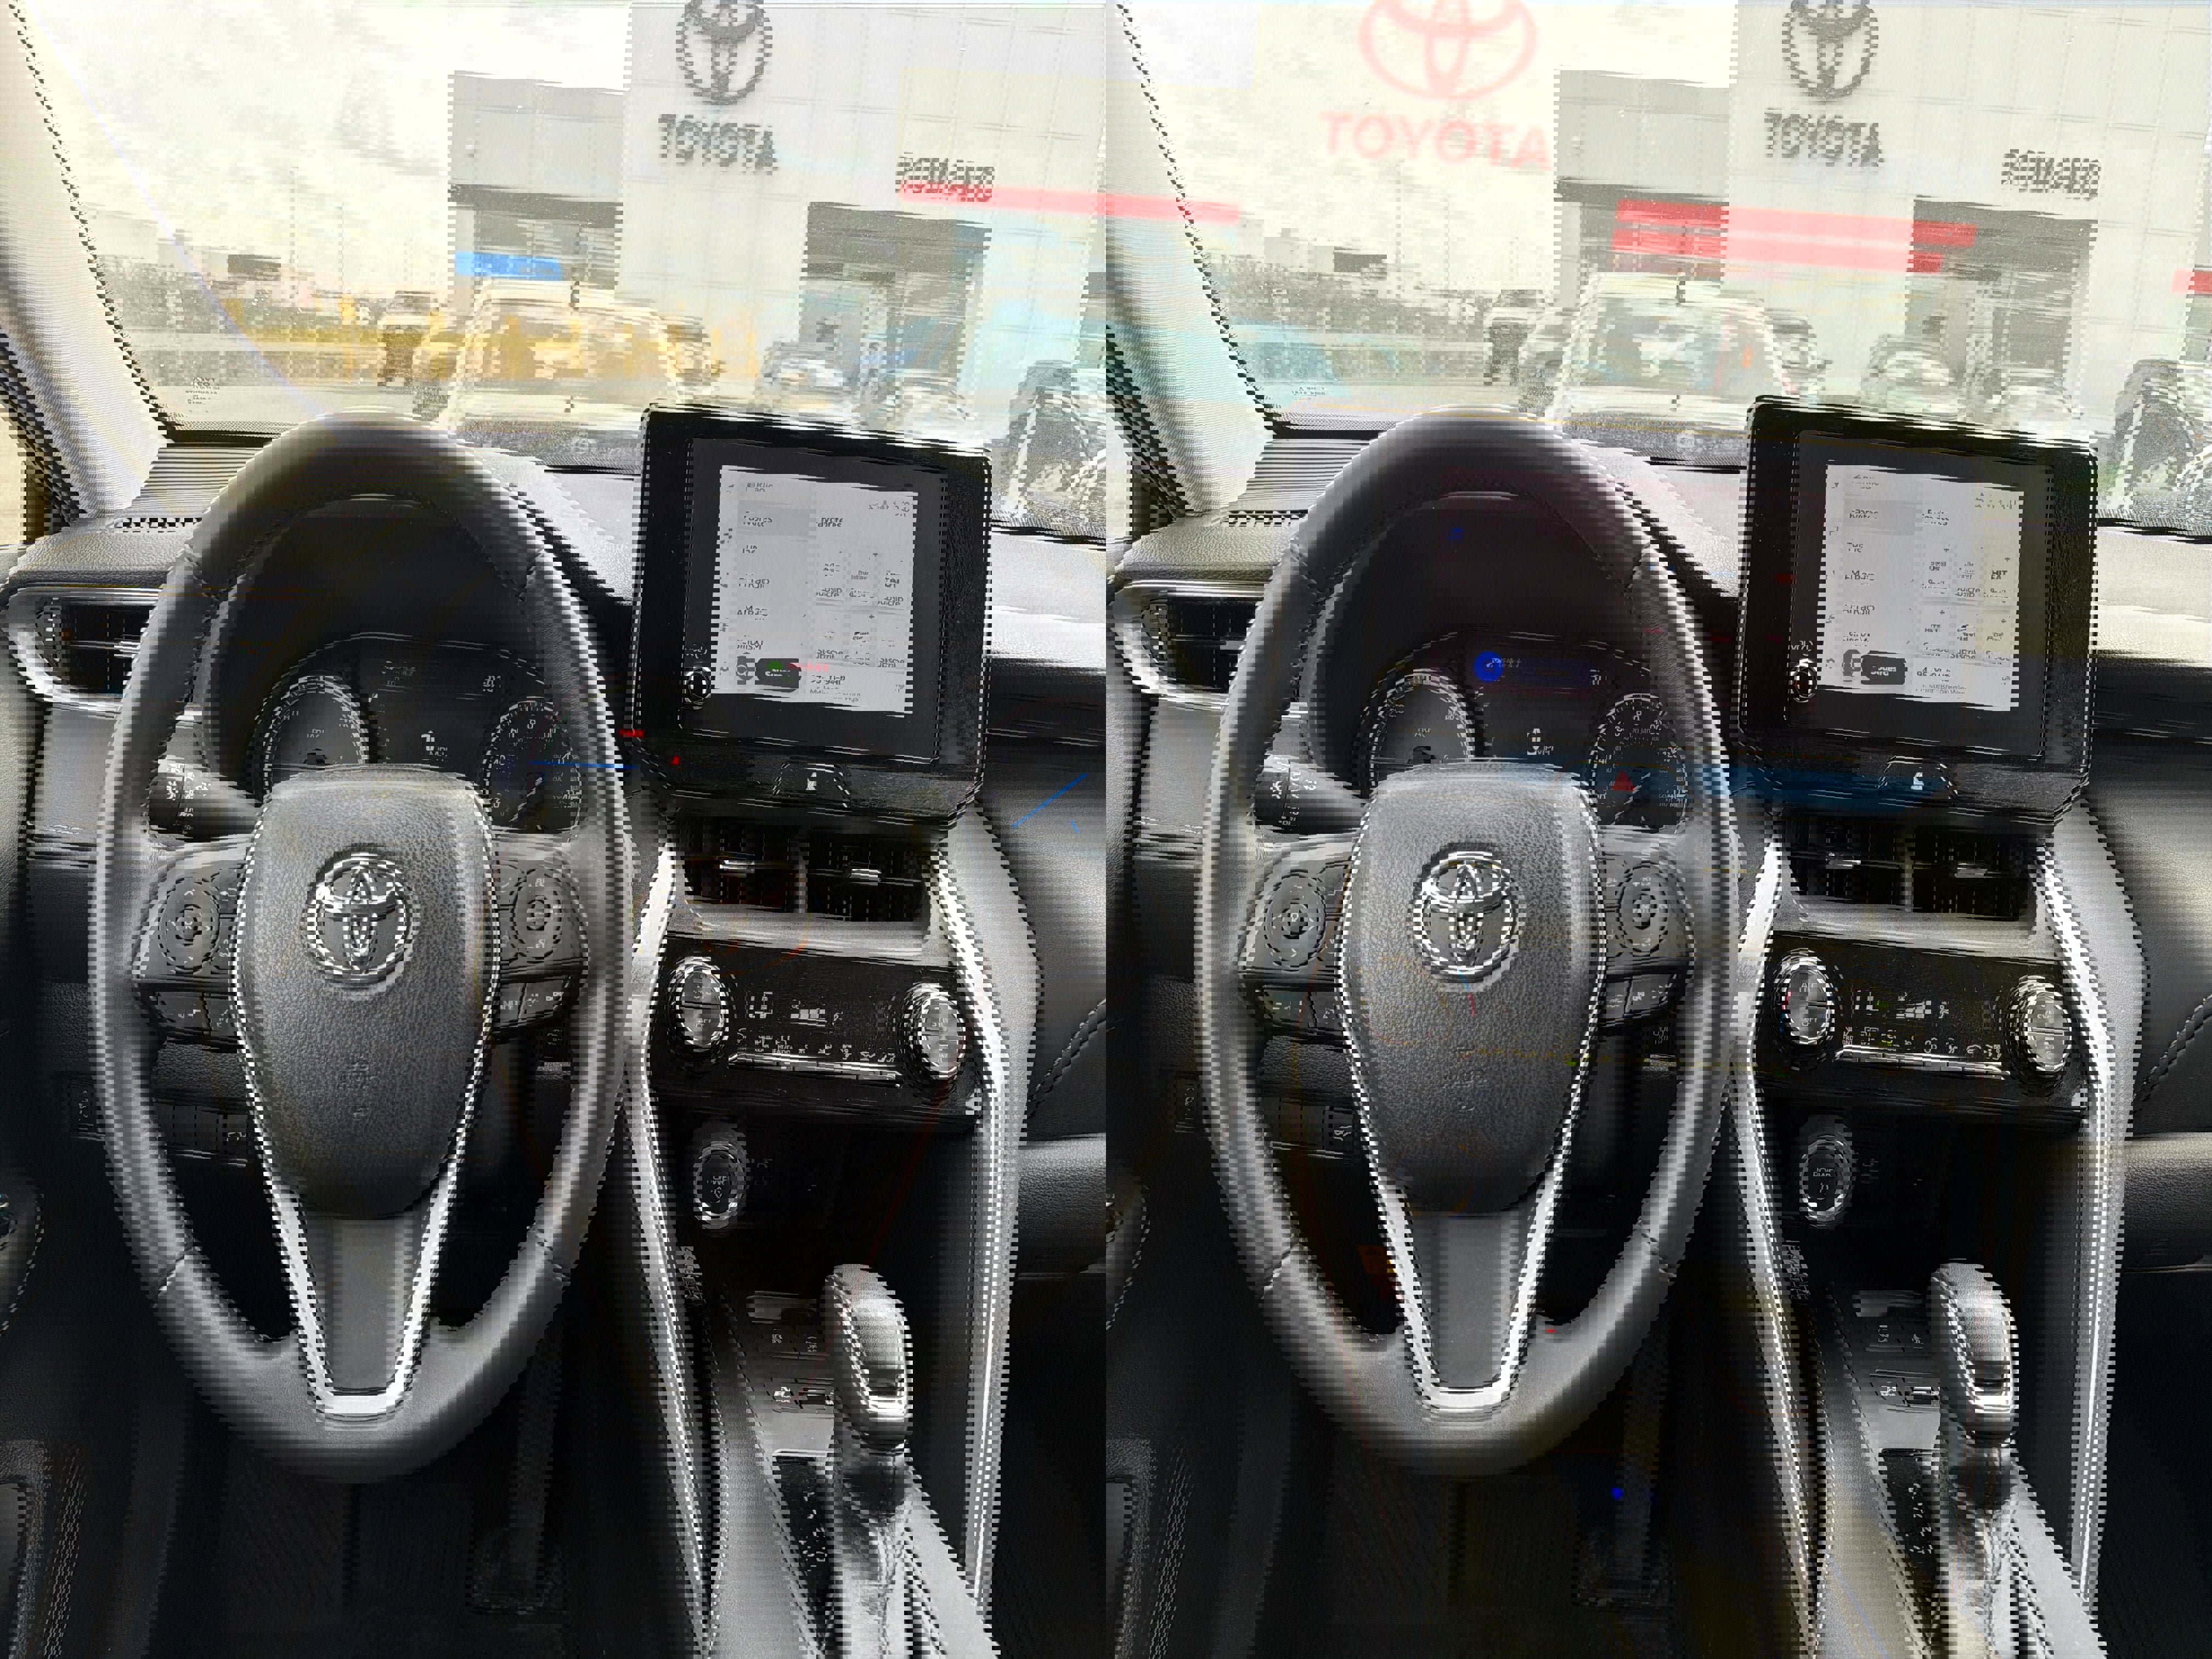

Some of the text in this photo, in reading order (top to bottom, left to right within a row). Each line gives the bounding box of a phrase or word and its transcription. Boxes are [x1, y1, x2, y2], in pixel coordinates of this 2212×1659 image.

[1318, 112, 1551, 171] TOYOTA
[1796, 152, 1988, 202] ROMANO
[1511, 481, 1538, 490] Radio
[1796, 501, 1819, 513] 3:01
[1489, 511, 1536, 523] Favorites
[1637, 514, 1684, 526] Favorites
[1487, 542, 1513, 553] Tune
[1709, 567, 1736, 579] highway
[1771, 572, 1797, 584] HEAT
[1485, 573, 1533, 585] FM Radio
[1638, 583, 1682, 594] Subscribe
[1700, 588, 1743, 599] Subscribe
[1762, 592, 1804, 603] Subscribe
[1481, 605, 1532, 616] AM Radio
[1480, 635, 1525, 647] SiriusXM
[1378, 644, 1395, 652] VOL
[1633, 647, 1677, 657] Subscribe
[1695, 651, 1739, 662] Subscribe
[1757, 655, 1801, 665] Subscribe
[1537, 666, 1573, 677] Sources
[1627, 671, 1647, 680] 94.5
[966, 673, 995, 689] 3:01
[1626, 685, 1719, 698] Mr. Mister Broken Wings
[573, 707, 589, 718] ECO
[681, 714, 700, 724] PWR
[1056, 714, 1069, 726] 80
[619, 729, 645, 738] PARK
[1019, 726, 1033, 737] 60
[1092, 724, 1109, 735] 100
[847, 729, 892, 757] 0 MPH
[992, 754, 1006, 766] 40
[1118, 751, 1135, 763] 120
[987, 793, 1001, 804] 20
[1127, 789, 1145, 800] 140
[363, 806, 387, 816] AUTO
[1061, 906, 1088, 916] CANCEL
[368, 917, 386, 926] OK
[1388, 986, 1415, 996] AUTO
[1003, 998, 1032, 1008] MODE
[1503, 990, 1541, 1015] LO
[1398, 1019, 1416, 1027] OFF
[1870, 1014, 1895, 1024] SYNC
[1100, 1029, 1120, 1037] ODO
[1101, 1037, 1119, 1046] TRIP
[1556, 1034, 1577, 1044] ECO
[1877, 1050, 1894, 1060] A/C
[1418, 1171, 1453, 1182] POWER
[1610, 1487, 1624, 1500] P
[1619, 1507, 1634, 1518] R
[1628, 1527, 1644, 1537] N
[1610, 1546, 1622, 1557] S
[1638, 1547, 1653, 1558] D
